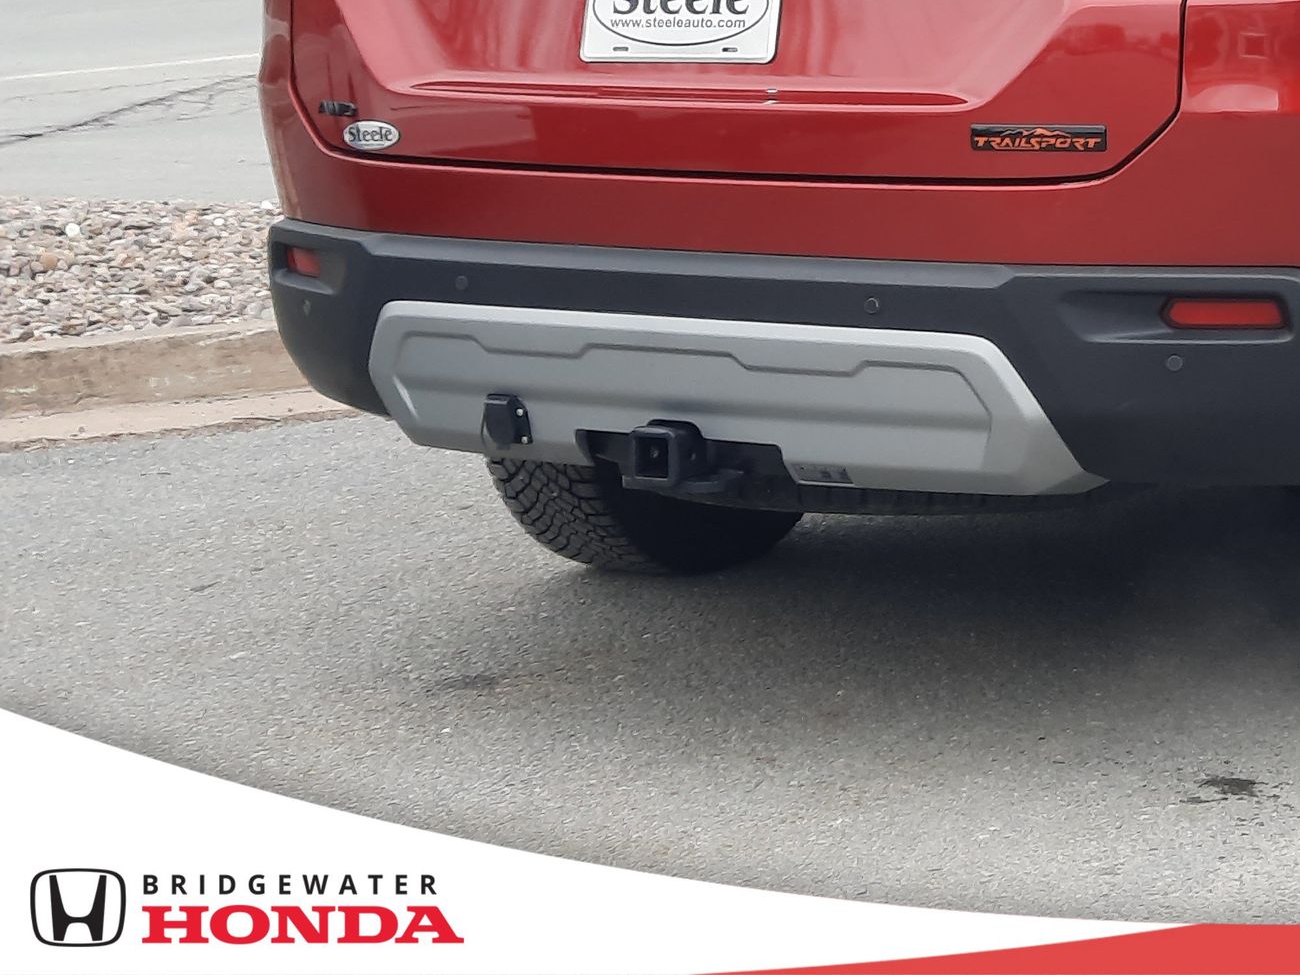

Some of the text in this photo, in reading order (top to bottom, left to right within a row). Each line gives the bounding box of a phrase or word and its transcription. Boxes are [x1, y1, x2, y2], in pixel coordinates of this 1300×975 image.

[610, 16, 746, 29] www.steeleauto.com
[348, 124, 393, 142] Steele
[974, 136, 1102, 151] TRAILSPORT
